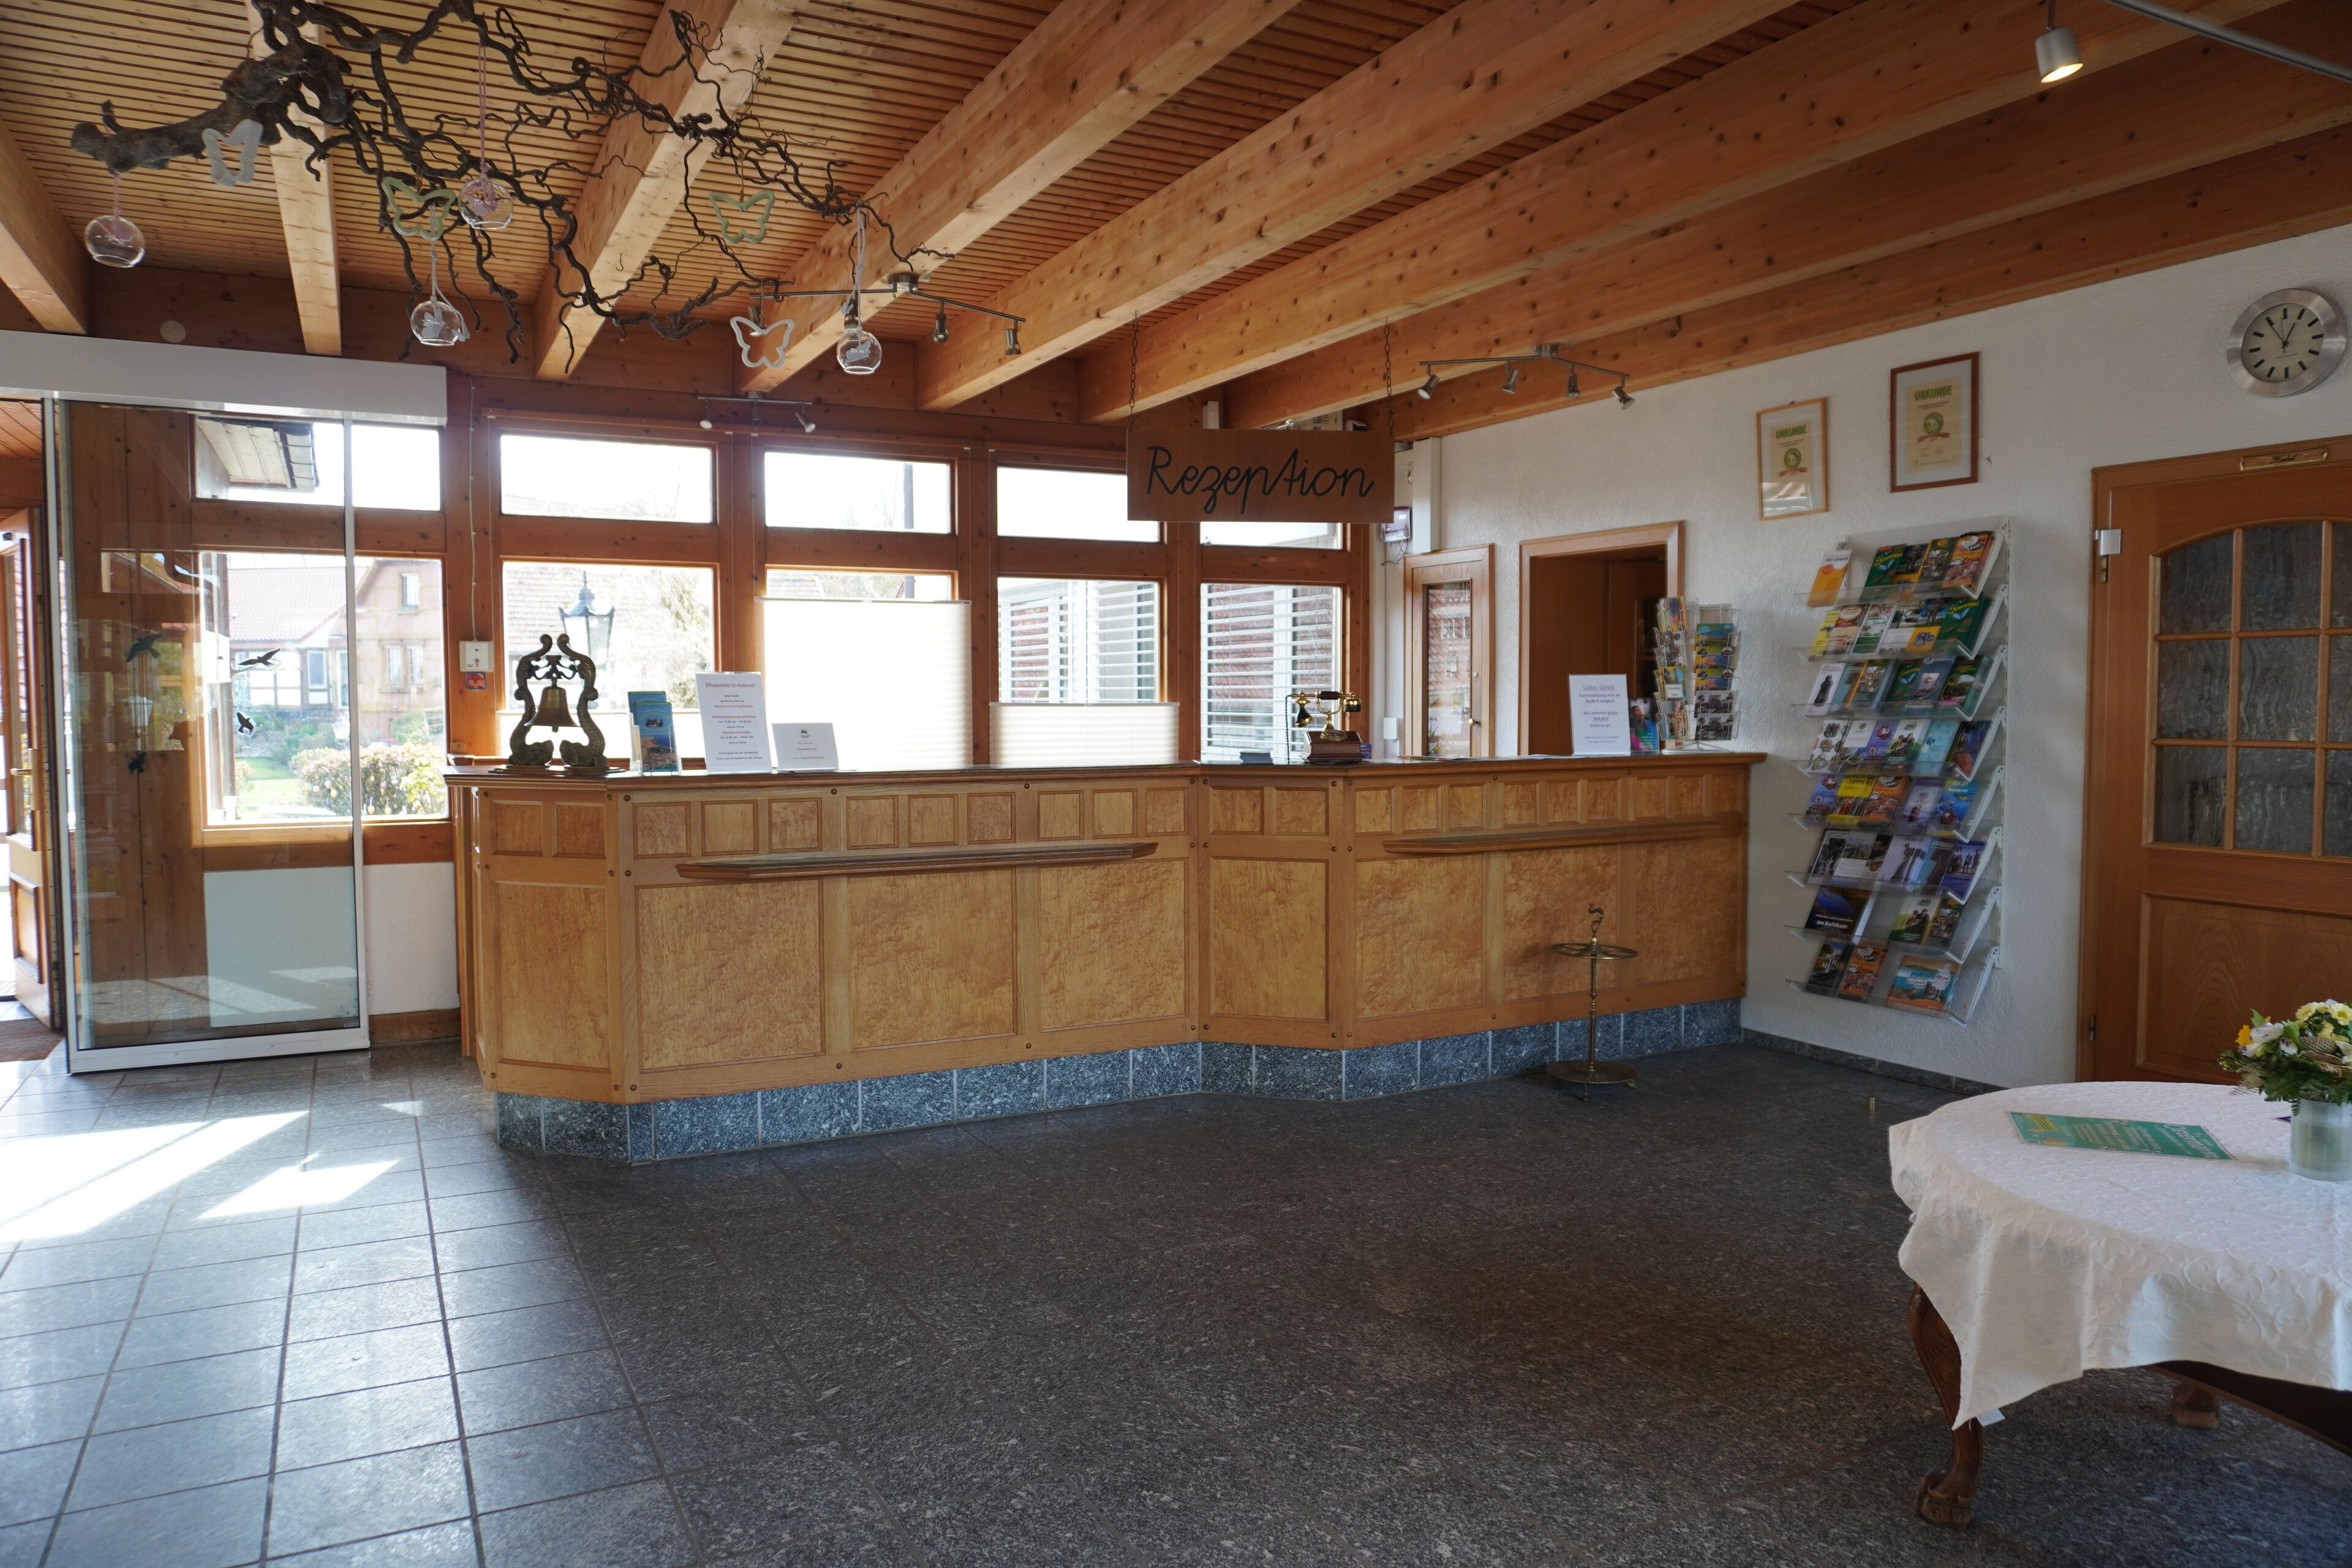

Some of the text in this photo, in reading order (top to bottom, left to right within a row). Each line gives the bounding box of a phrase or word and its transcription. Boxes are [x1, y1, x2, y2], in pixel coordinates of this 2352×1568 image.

[1915, 385, 1952, 401] URKUNDE
[1776, 424, 1806, 439] URKUNDE
[1147, 446, 1374, 514] Rezeption
[1825, 921, 1848, 929] Baltikum
